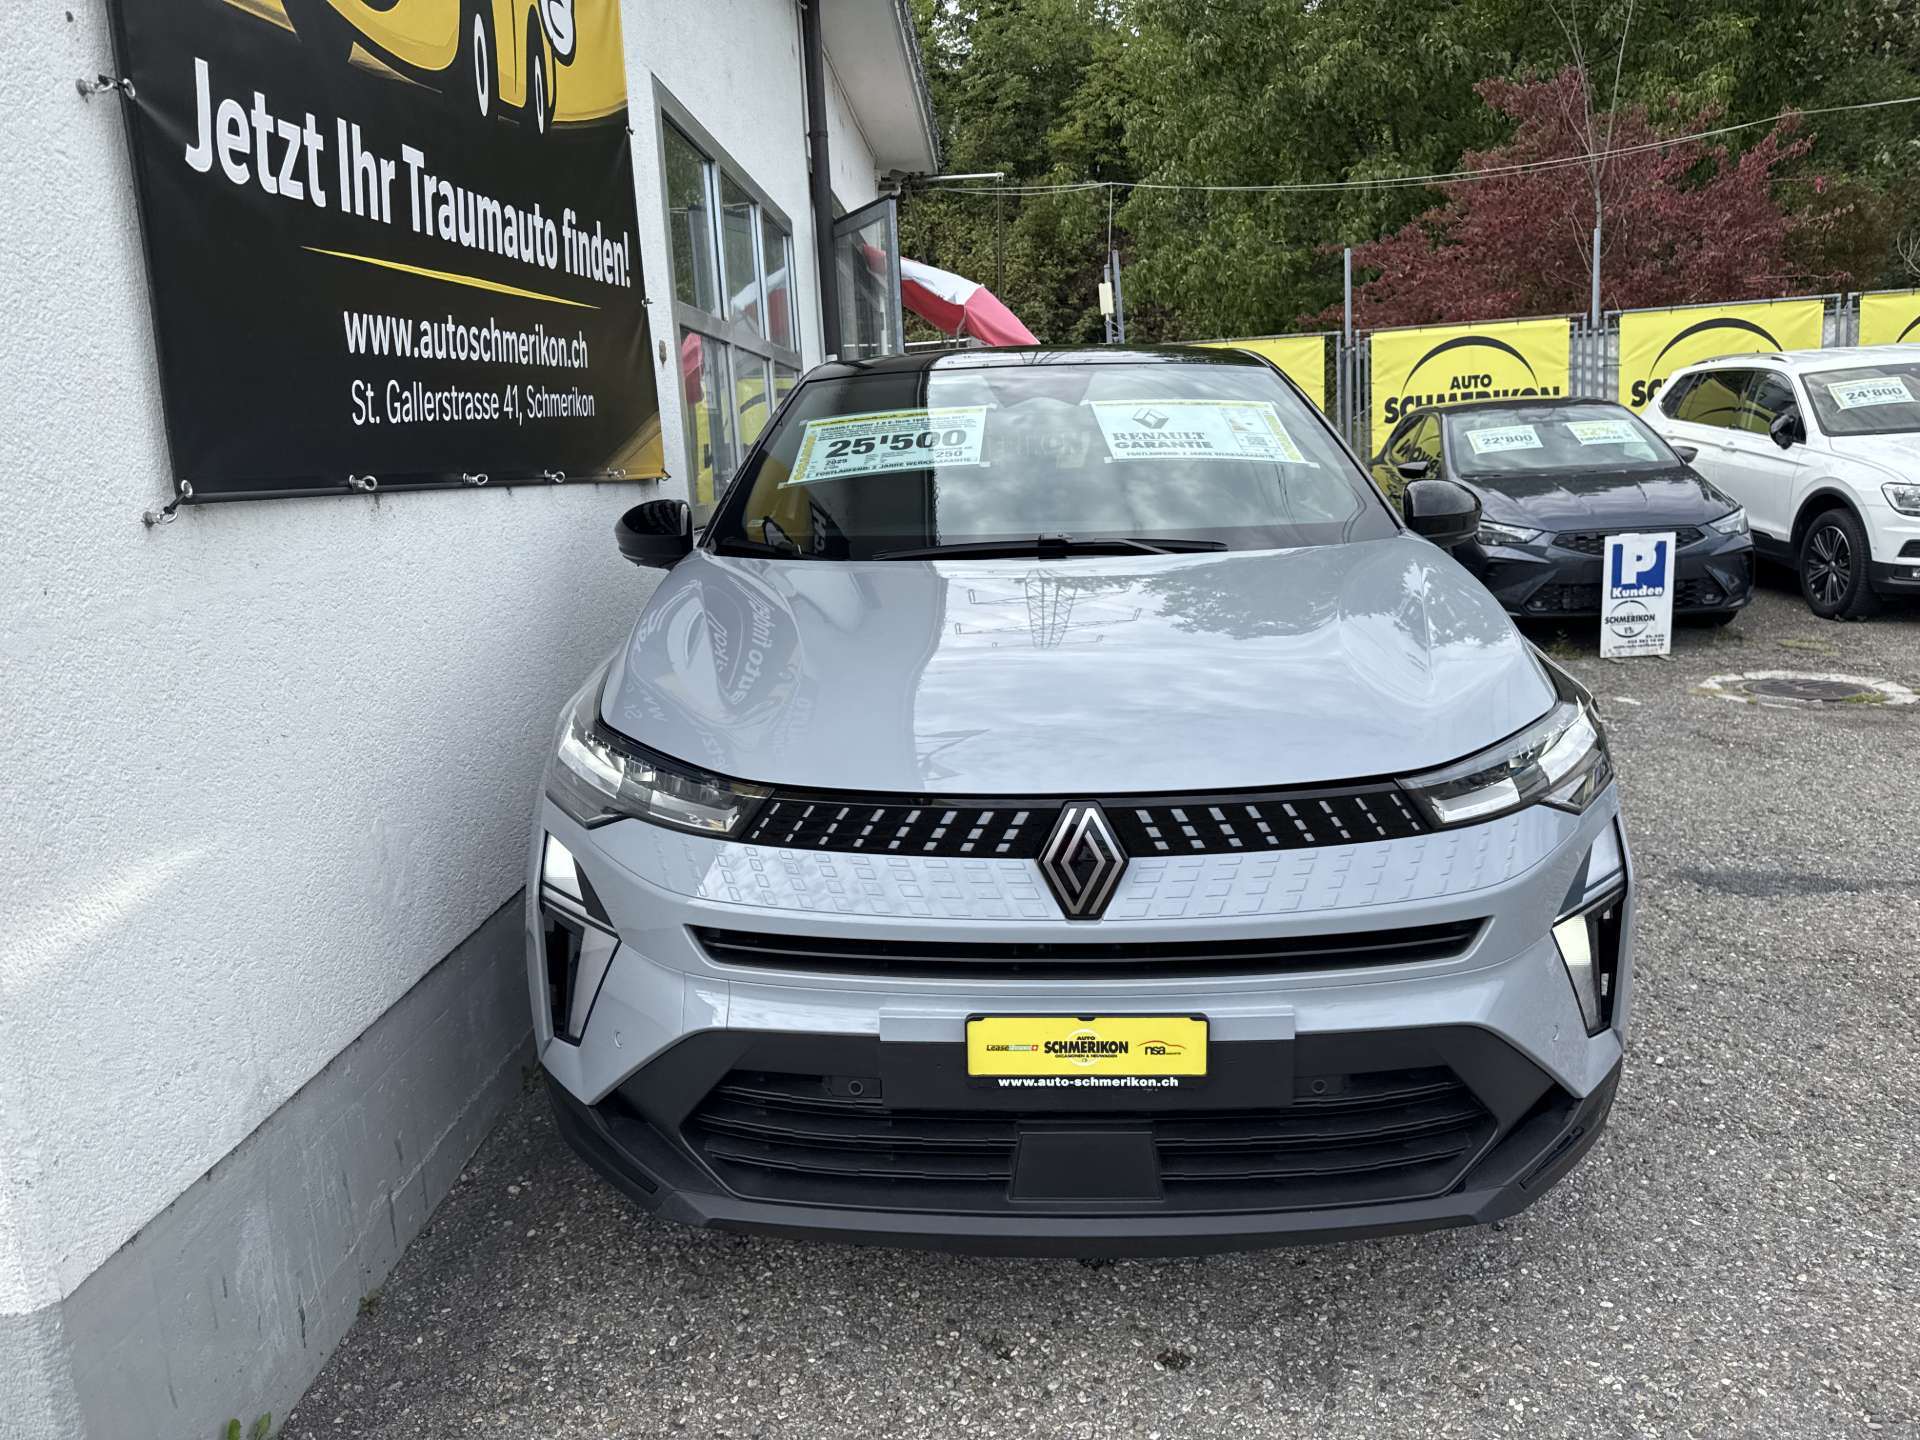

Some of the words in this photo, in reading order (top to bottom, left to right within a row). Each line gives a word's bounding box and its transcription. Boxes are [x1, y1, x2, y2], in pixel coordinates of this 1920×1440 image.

[185, 57, 326, 208] Jetzt
[336, 117, 397, 224] Ihr
[401, 143, 558, 271] Traumauto
[562, 207, 632, 288] finden!
[343, 310, 589, 369] www.autoschmerikon.ch
[1450, 373, 1493, 390] AUTO
[1846, 387, 1903, 401] 24'800
[351, 379, 381, 426] St.
[385, 381, 500, 422] Gallerstrasse
[503, 390, 523, 427] 41,
[526, 387, 596, 419] Schmerikon
[1112, 431, 1205, 441] RENAULT
[825, 429, 967, 459] 25'500
[1114, 441, 1214, 449] GARANTIE
[935, 450, 964, 458] 250
[1612, 586, 1663, 598] Kunden
[1044, 1040, 1129, 1054] SCHMERIKON
[1144, 1046, 1166, 1055] nsa
[998, 1077, 1179, 1087] www.auto-schmerikon.ch
